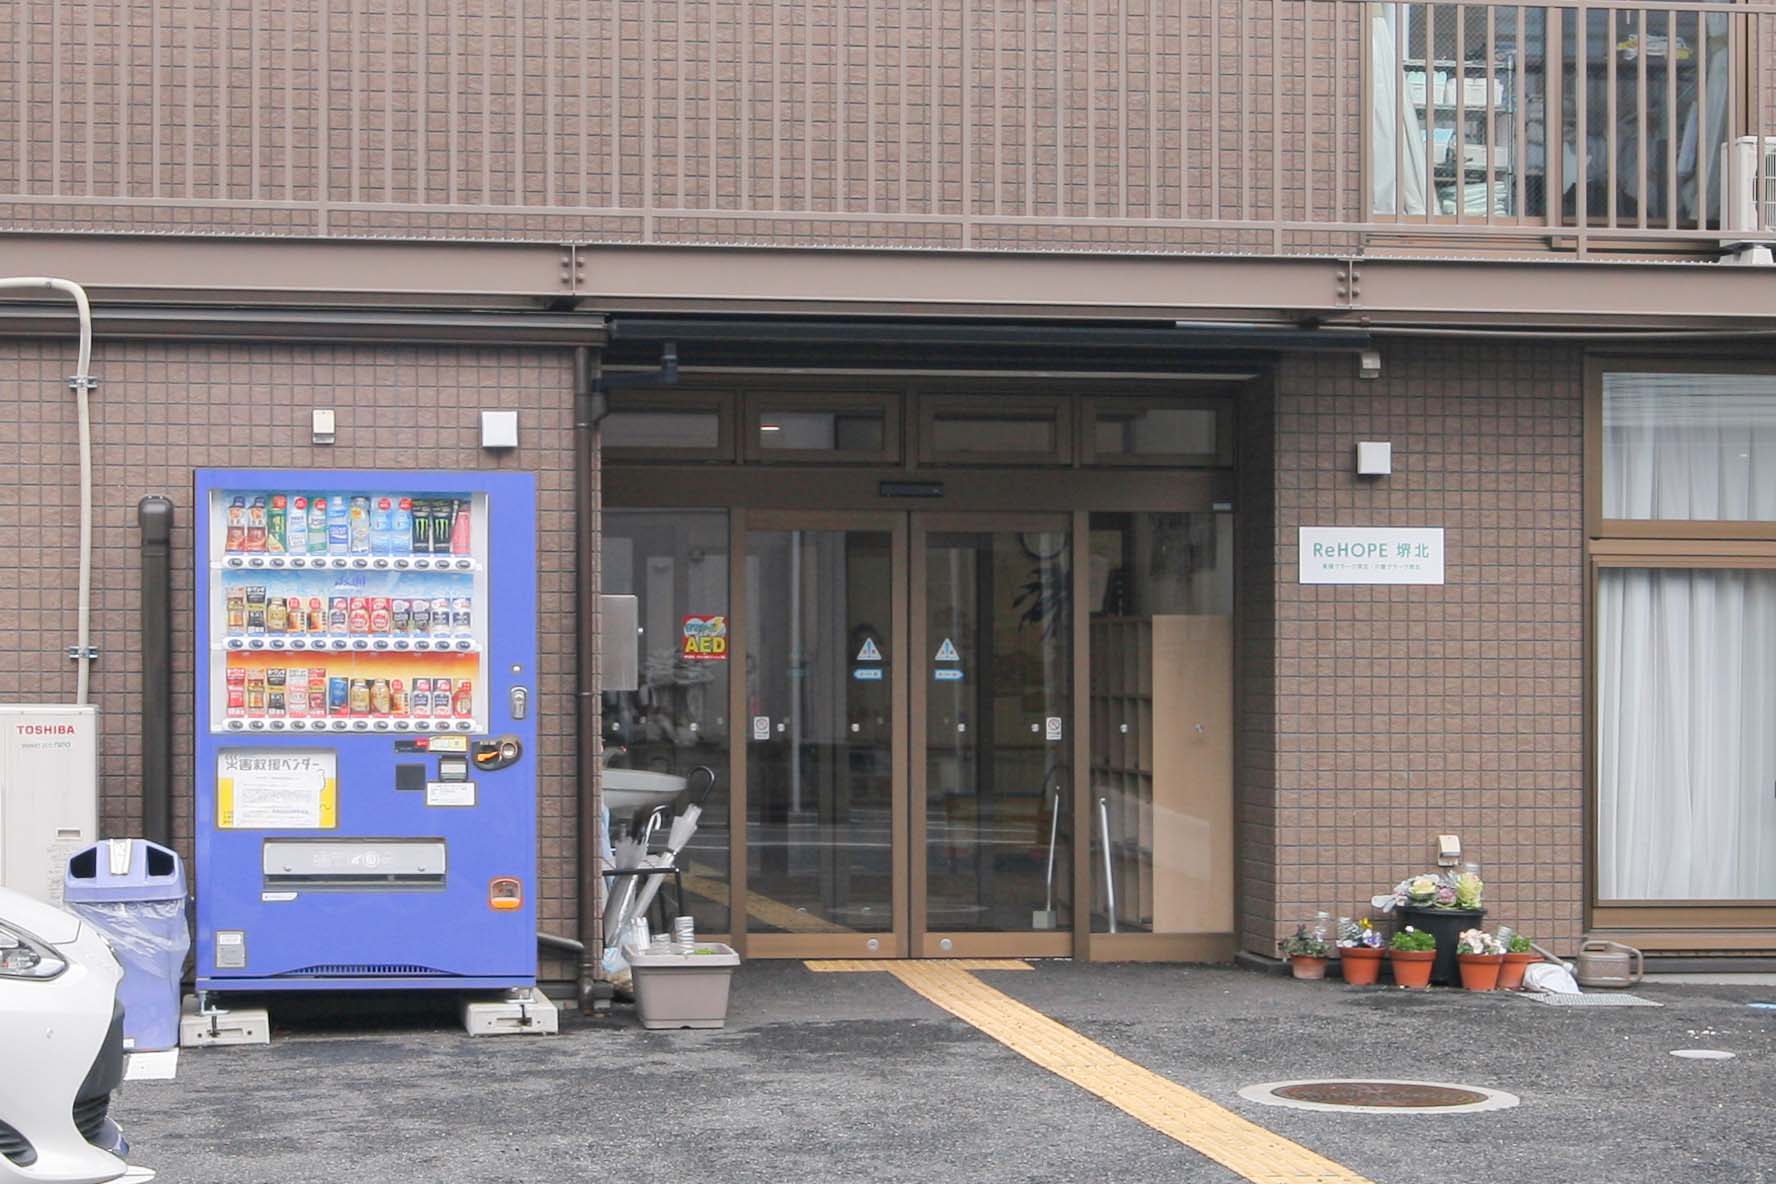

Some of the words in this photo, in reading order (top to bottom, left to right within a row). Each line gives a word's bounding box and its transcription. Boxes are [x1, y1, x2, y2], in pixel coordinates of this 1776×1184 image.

[1313, 542, 1388, 558] ReHOPE
[1396, 543, 1430, 559] 堺北
[684, 636, 726, 653] AED
[16, 725, 75, 735] TOSHIBA
